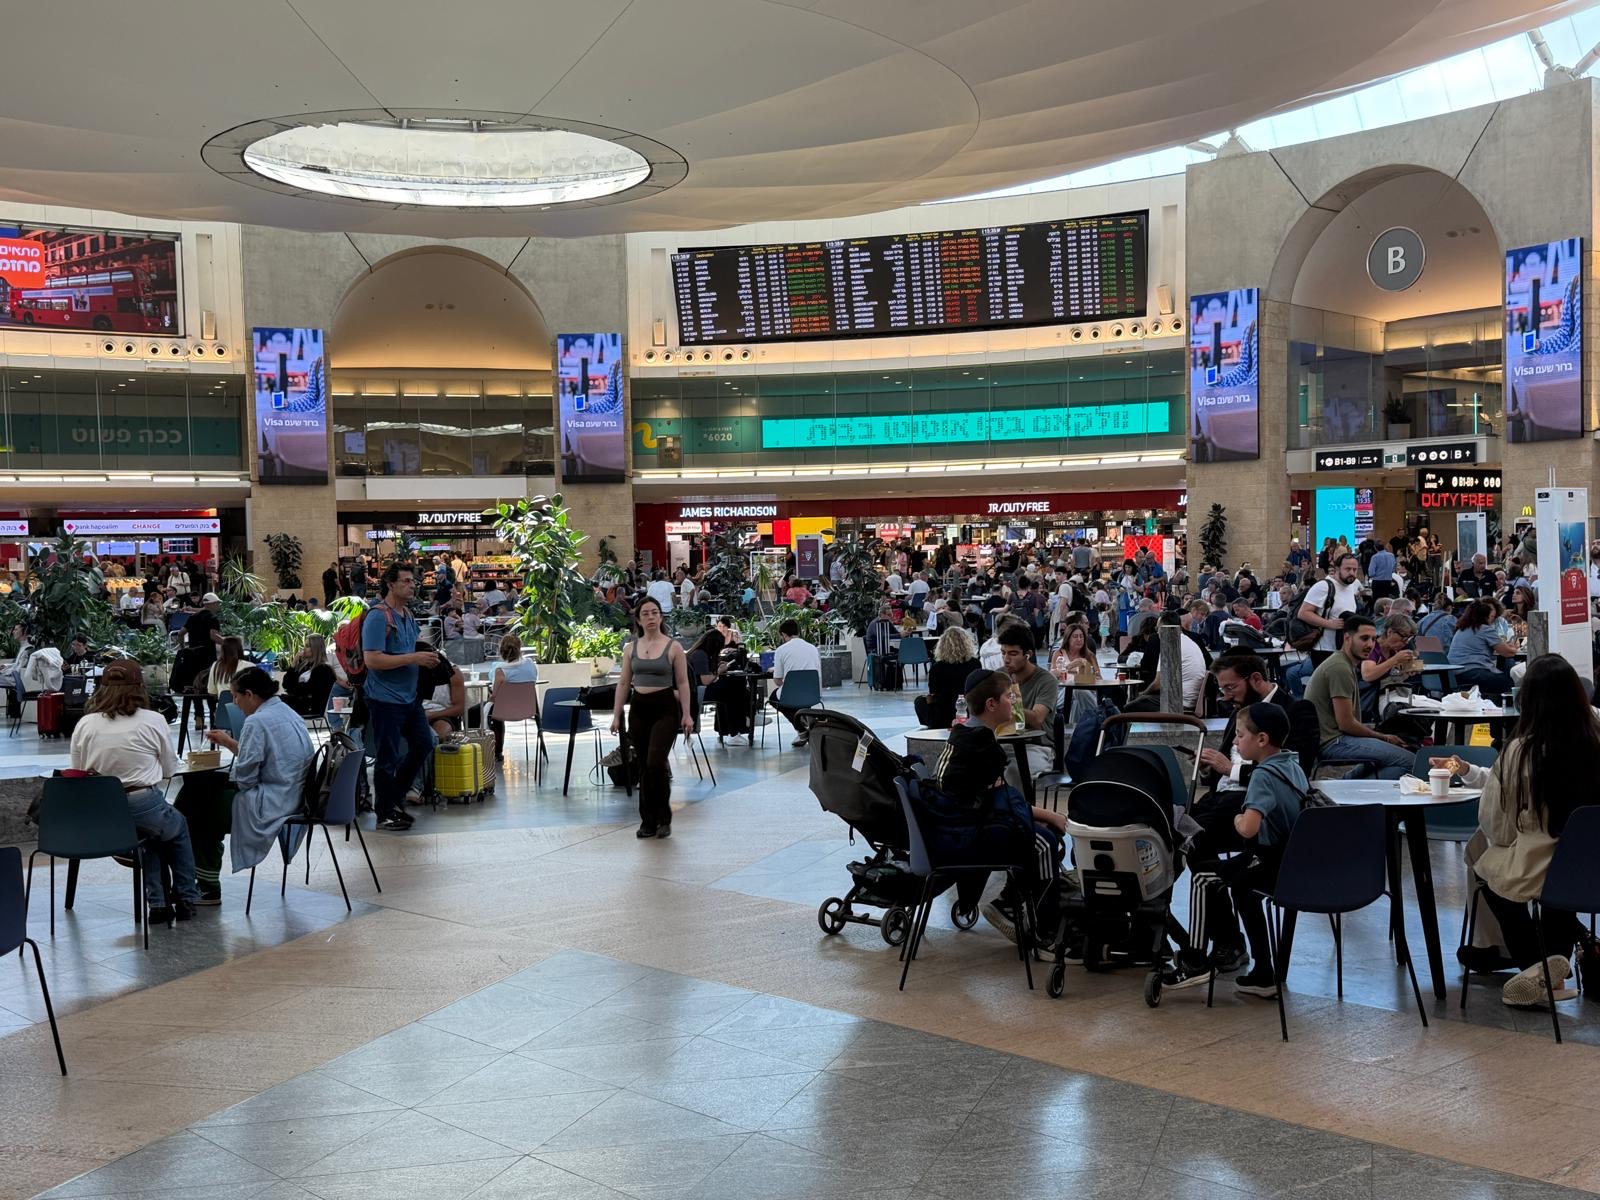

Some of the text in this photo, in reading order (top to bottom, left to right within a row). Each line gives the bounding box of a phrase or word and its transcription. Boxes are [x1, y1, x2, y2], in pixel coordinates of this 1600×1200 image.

[0, 246, 40, 257] מתאים
[1388, 247, 1405, 274] B
[1514, 366, 1534, 376] Visa
[1198, 396, 1216, 406] Visa
[264, 418, 283, 426] Visa
[71, 428, 182, 444] ככה פשוט
[1454, 450, 1462, 459] B
[1334, 457, 1356, 466] B1-B9
[1422, 493, 1494, 507] DUTY FREE
[680, 506, 777, 517] JAMES RICHARDSON
[988, 502, 1050, 513] JR/DUTY FREE
[417, 513, 482, 523] JR/DUTY FREE
